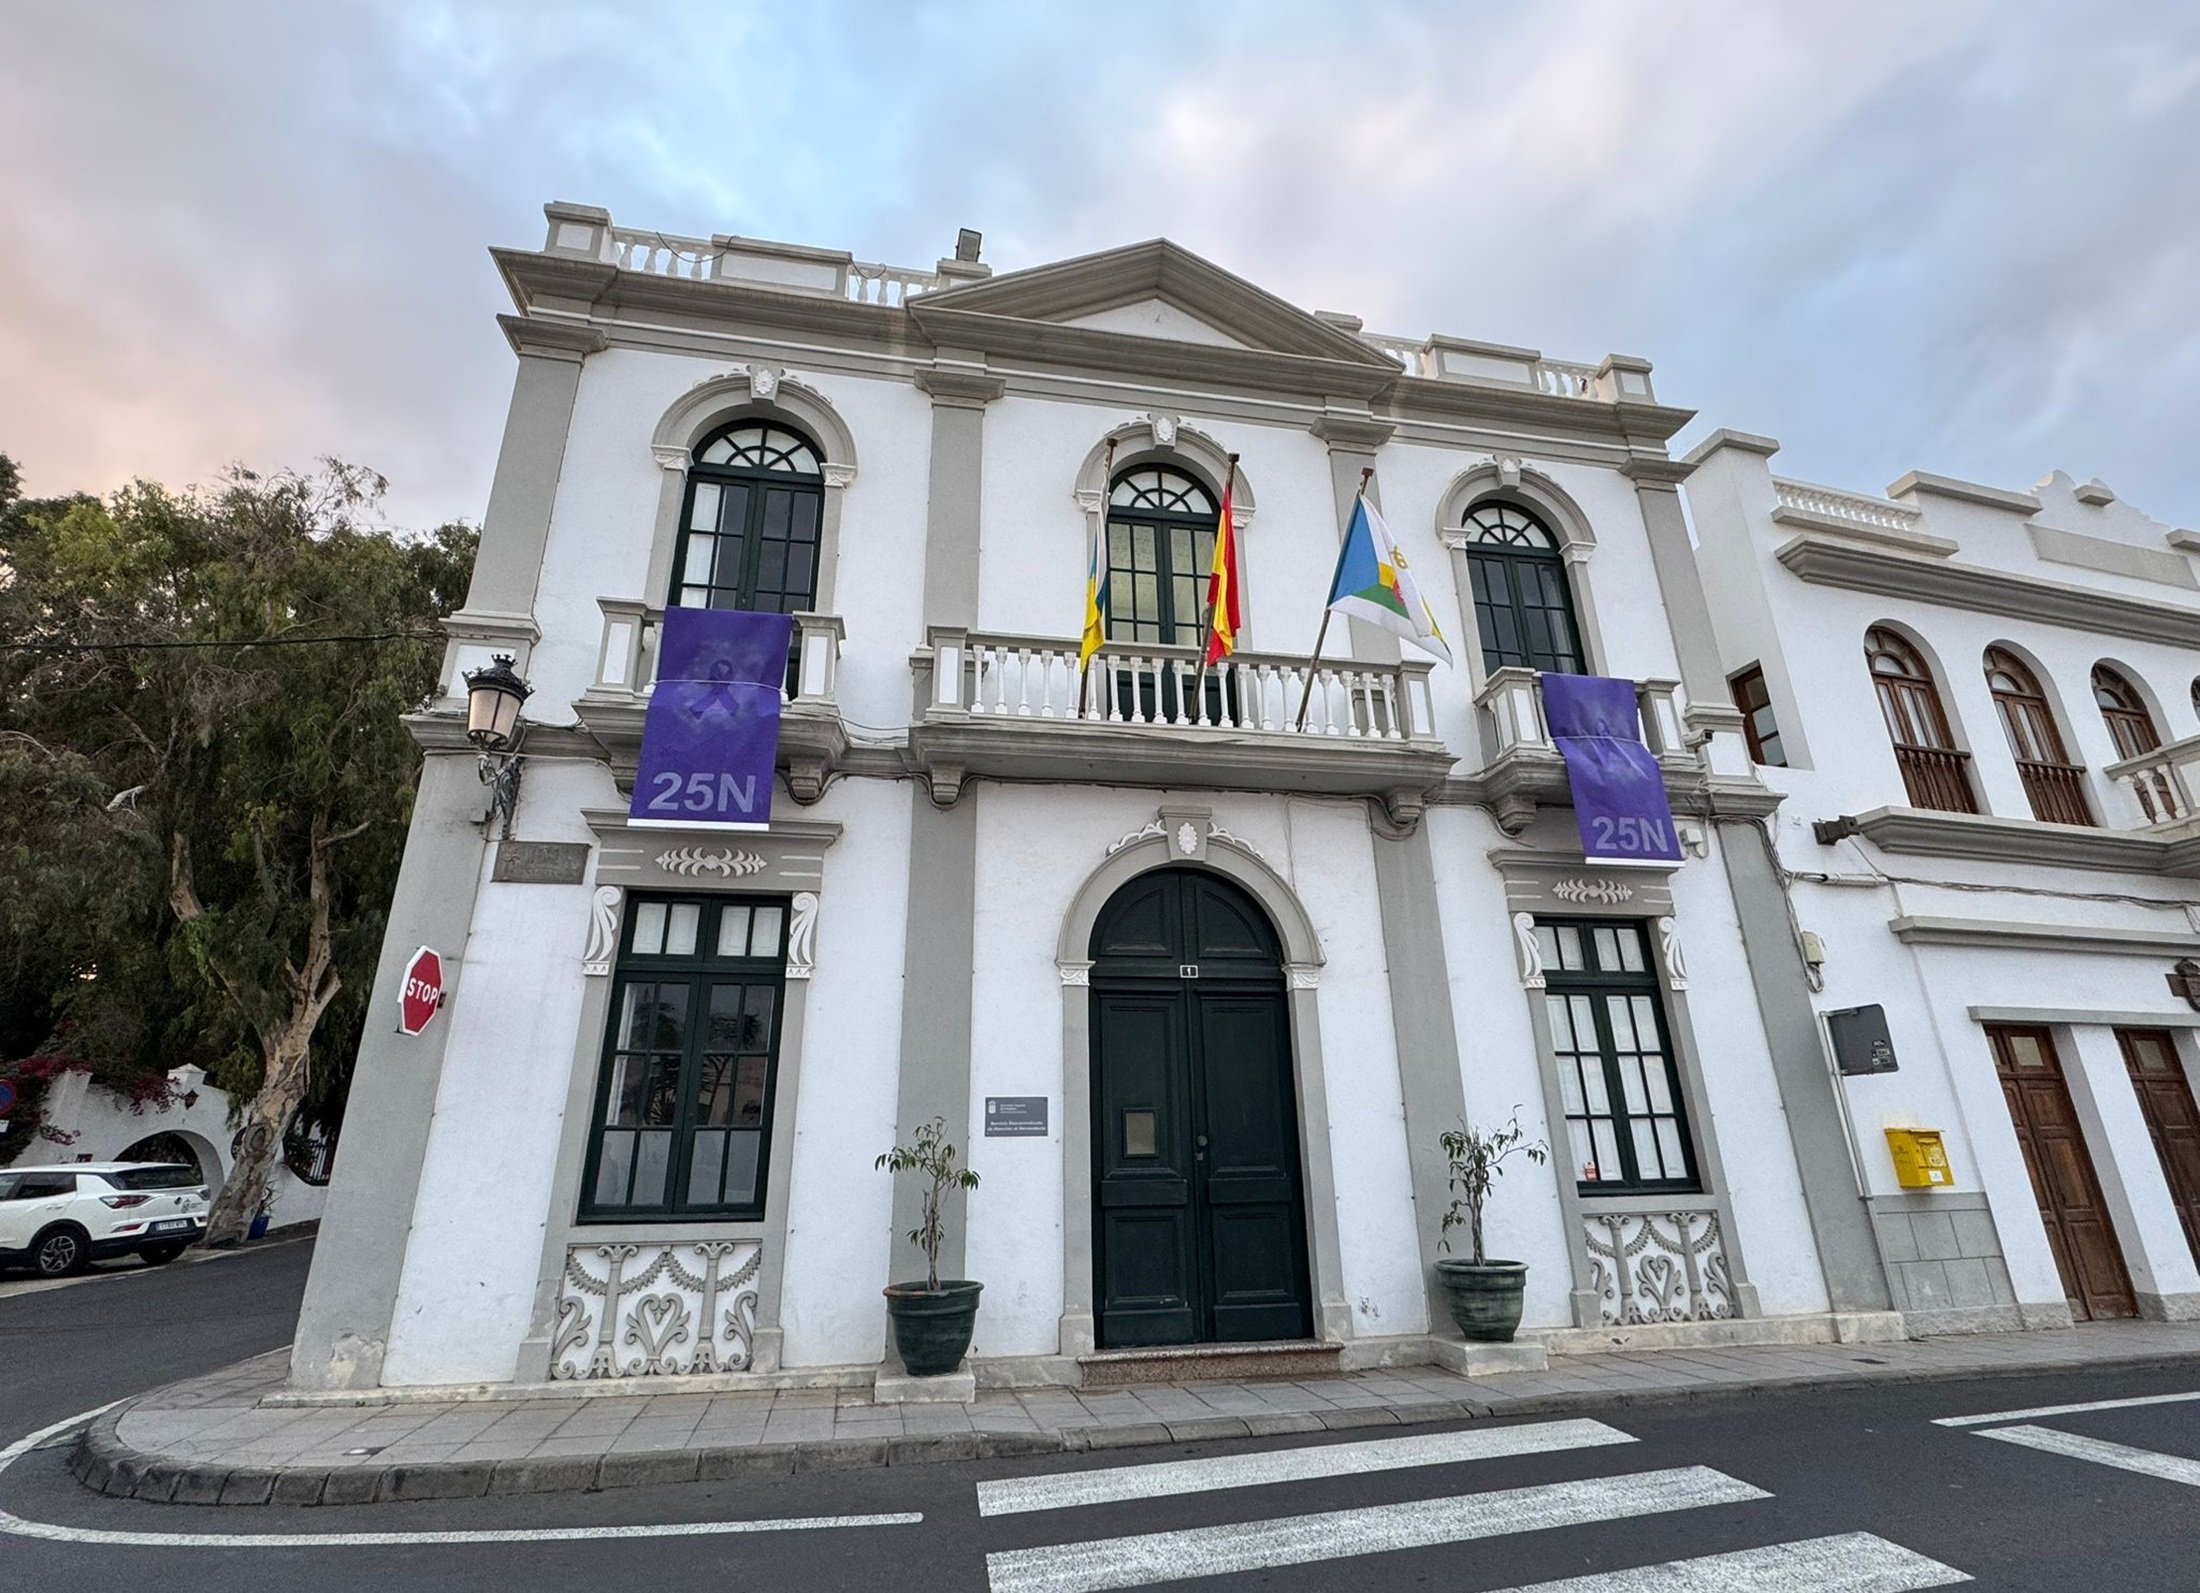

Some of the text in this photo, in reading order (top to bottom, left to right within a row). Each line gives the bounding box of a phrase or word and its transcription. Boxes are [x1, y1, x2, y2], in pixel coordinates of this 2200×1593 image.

[648, 772, 757, 813] 25N
[1592, 816, 1669, 852] 25N
[407, 978, 438, 1005] STOP
